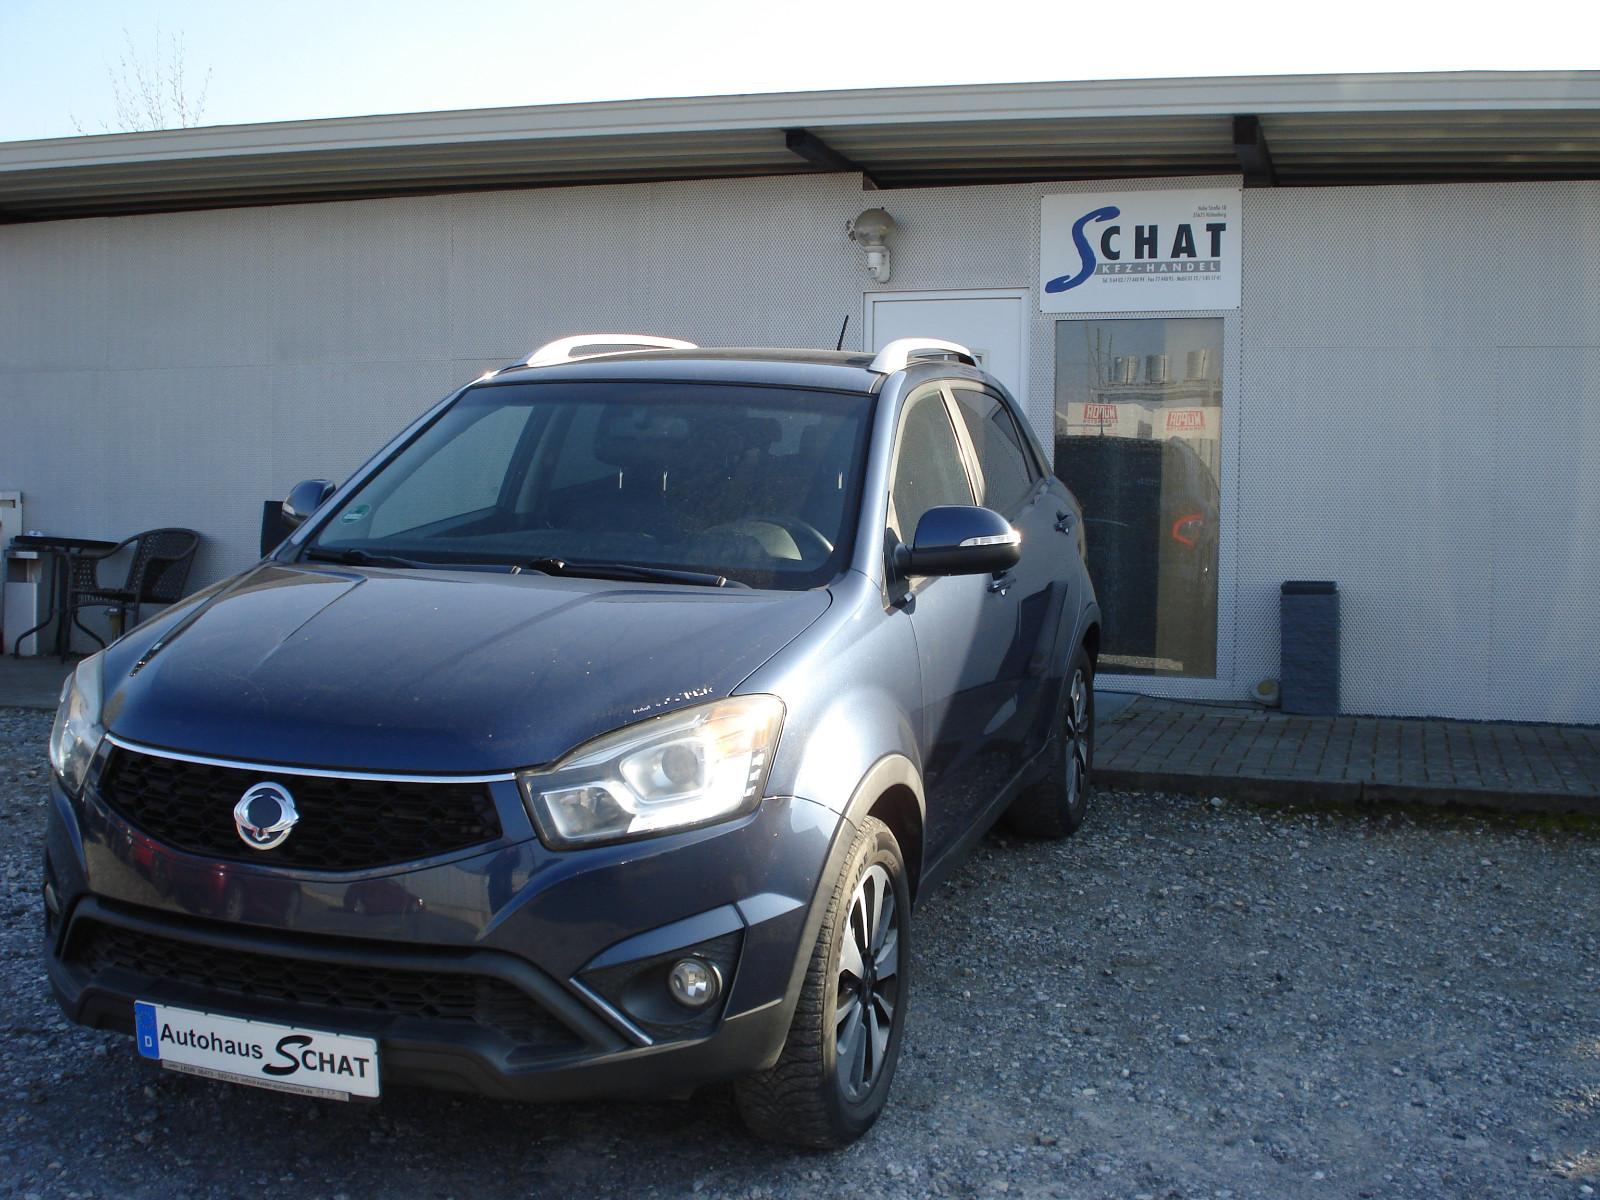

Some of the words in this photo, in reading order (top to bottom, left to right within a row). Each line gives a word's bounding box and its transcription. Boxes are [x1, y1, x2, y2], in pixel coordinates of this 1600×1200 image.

[1045, 206, 1227, 294] SCHAT
[1102, 261, 1217, 275] KFZ-HANDEL
[144, 1035, 153, 1048] D
[160, 1023, 264, 1060] Autohaus
[262, 1034, 370, 1078] SCHAT
